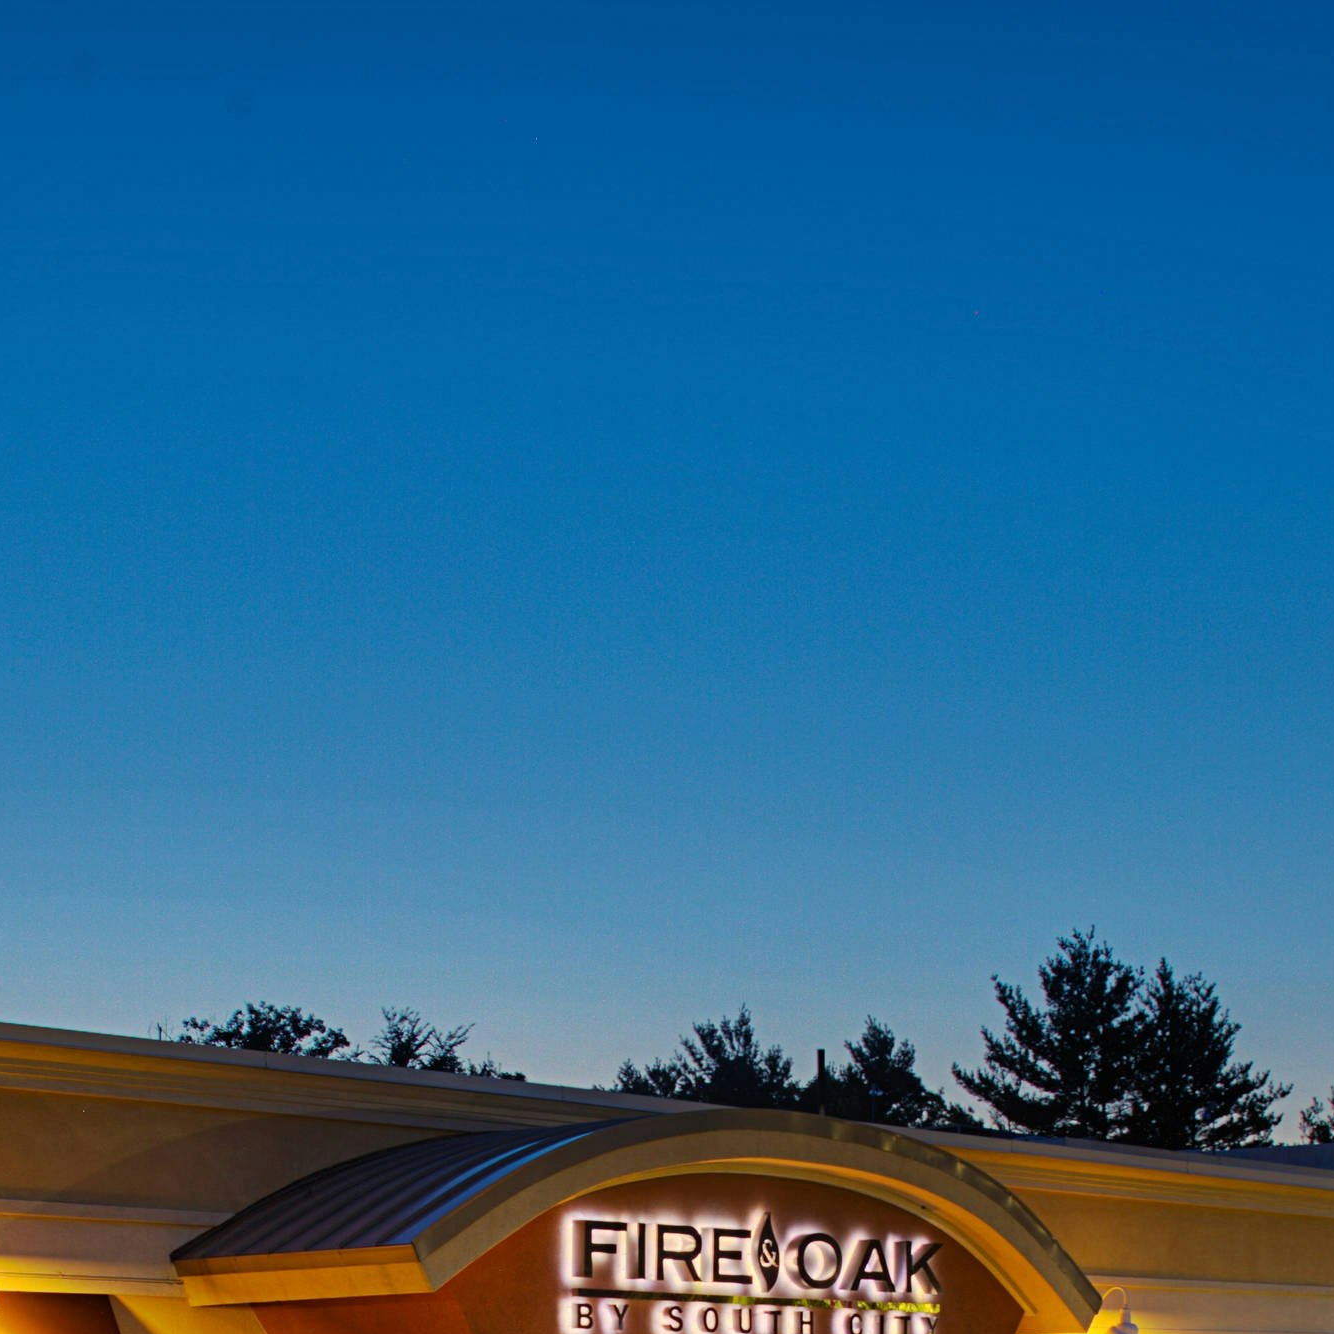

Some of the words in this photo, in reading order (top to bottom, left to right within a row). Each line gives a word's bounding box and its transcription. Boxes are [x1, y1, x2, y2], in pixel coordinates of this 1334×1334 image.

[572, 1219, 754, 1286] FIRE
[759, 1238, 779, 1269] &
[785, 1231, 944, 1295] OAK
[576, 1303, 629, 1331] BY
